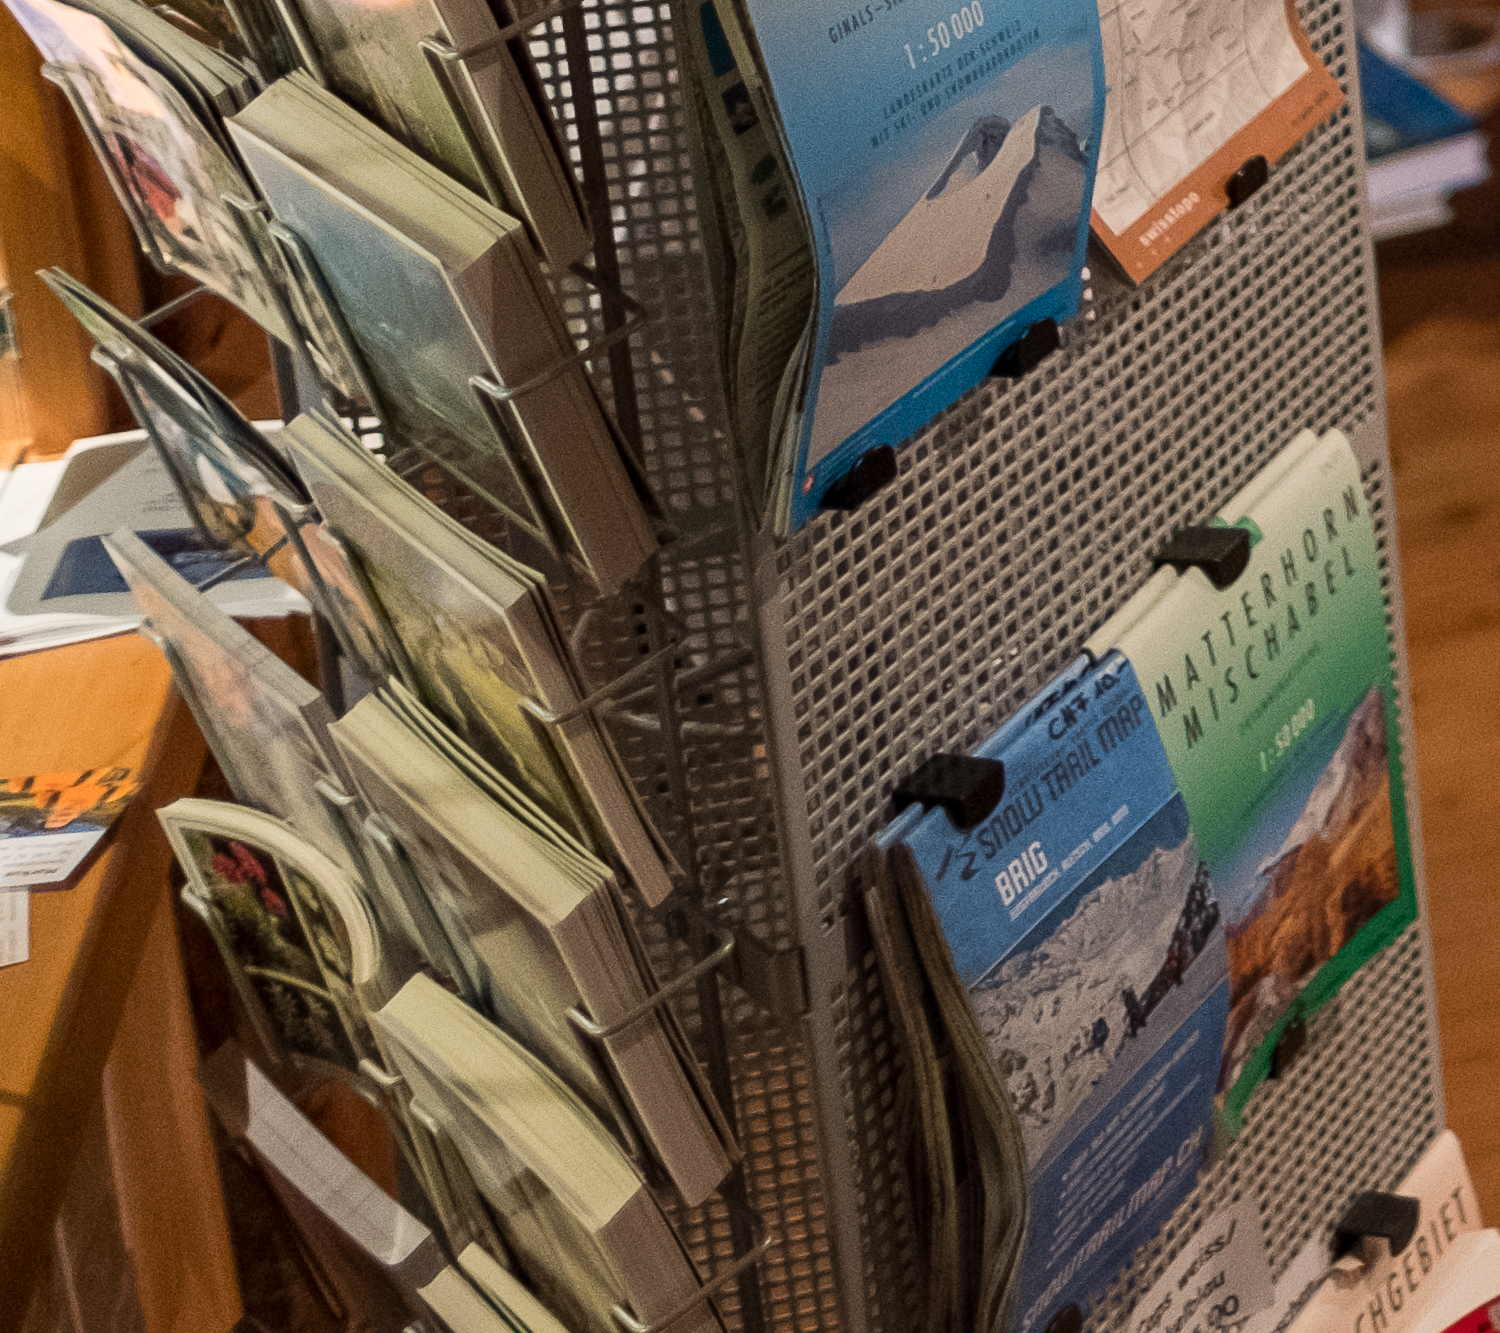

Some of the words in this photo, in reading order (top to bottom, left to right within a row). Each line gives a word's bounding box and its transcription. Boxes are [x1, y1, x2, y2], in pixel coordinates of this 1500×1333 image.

[1156, 485, 1360, 718] MATTERHORN
[1182, 545, 1356, 750] MISCHABEL
[976, 782, 1044, 861] SNOW
[1040, 744, 1100, 802] TRAIL
[1096, 693, 1145, 755] MAP
[993, 840, 1049, 908] BRIG
